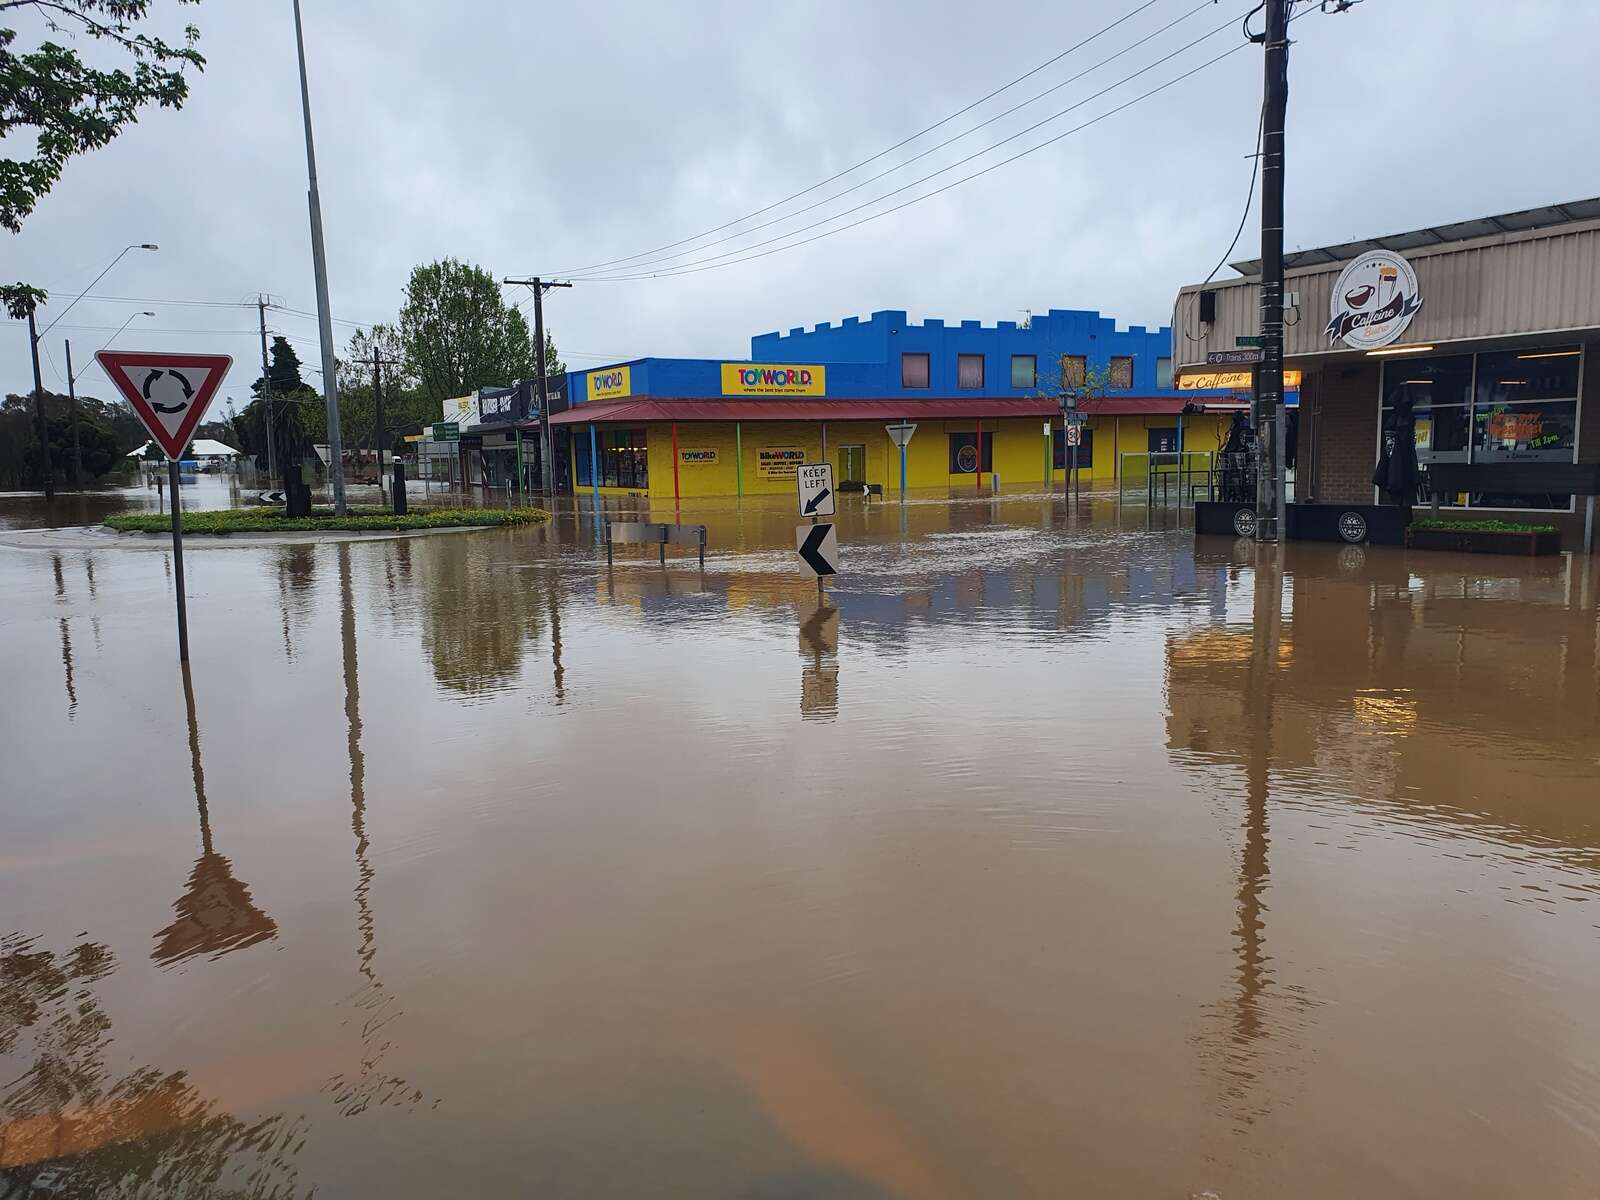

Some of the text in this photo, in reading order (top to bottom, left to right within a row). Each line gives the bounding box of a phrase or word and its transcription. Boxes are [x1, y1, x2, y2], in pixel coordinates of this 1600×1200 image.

[1352, 308, 1394, 327] Caffeine
[1243, 352, 1259, 361] 300m
[1196, 372, 1244, 389] Caffeine
[803, 468, 827, 478] KEEP
[804, 479, 826, 489] LEFT
